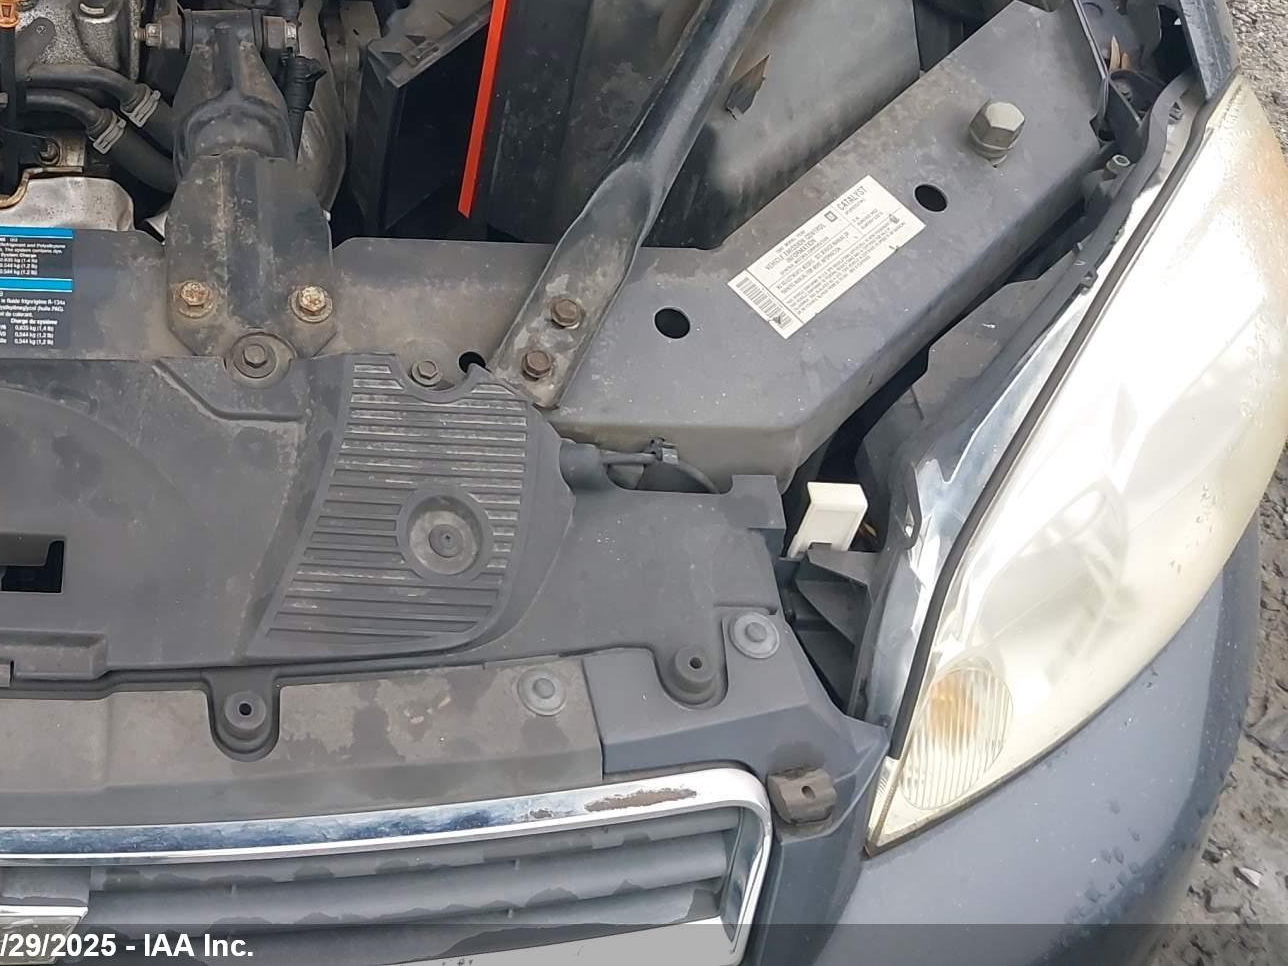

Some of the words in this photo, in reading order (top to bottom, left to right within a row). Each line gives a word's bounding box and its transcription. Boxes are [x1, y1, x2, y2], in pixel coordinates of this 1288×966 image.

[837, 186, 866, 210] CATALYST
[766, 254, 784, 270] VEHICLE
[783, 239, 805, 256] EMISSION
[805, 224, 826, 239] CONTROL
